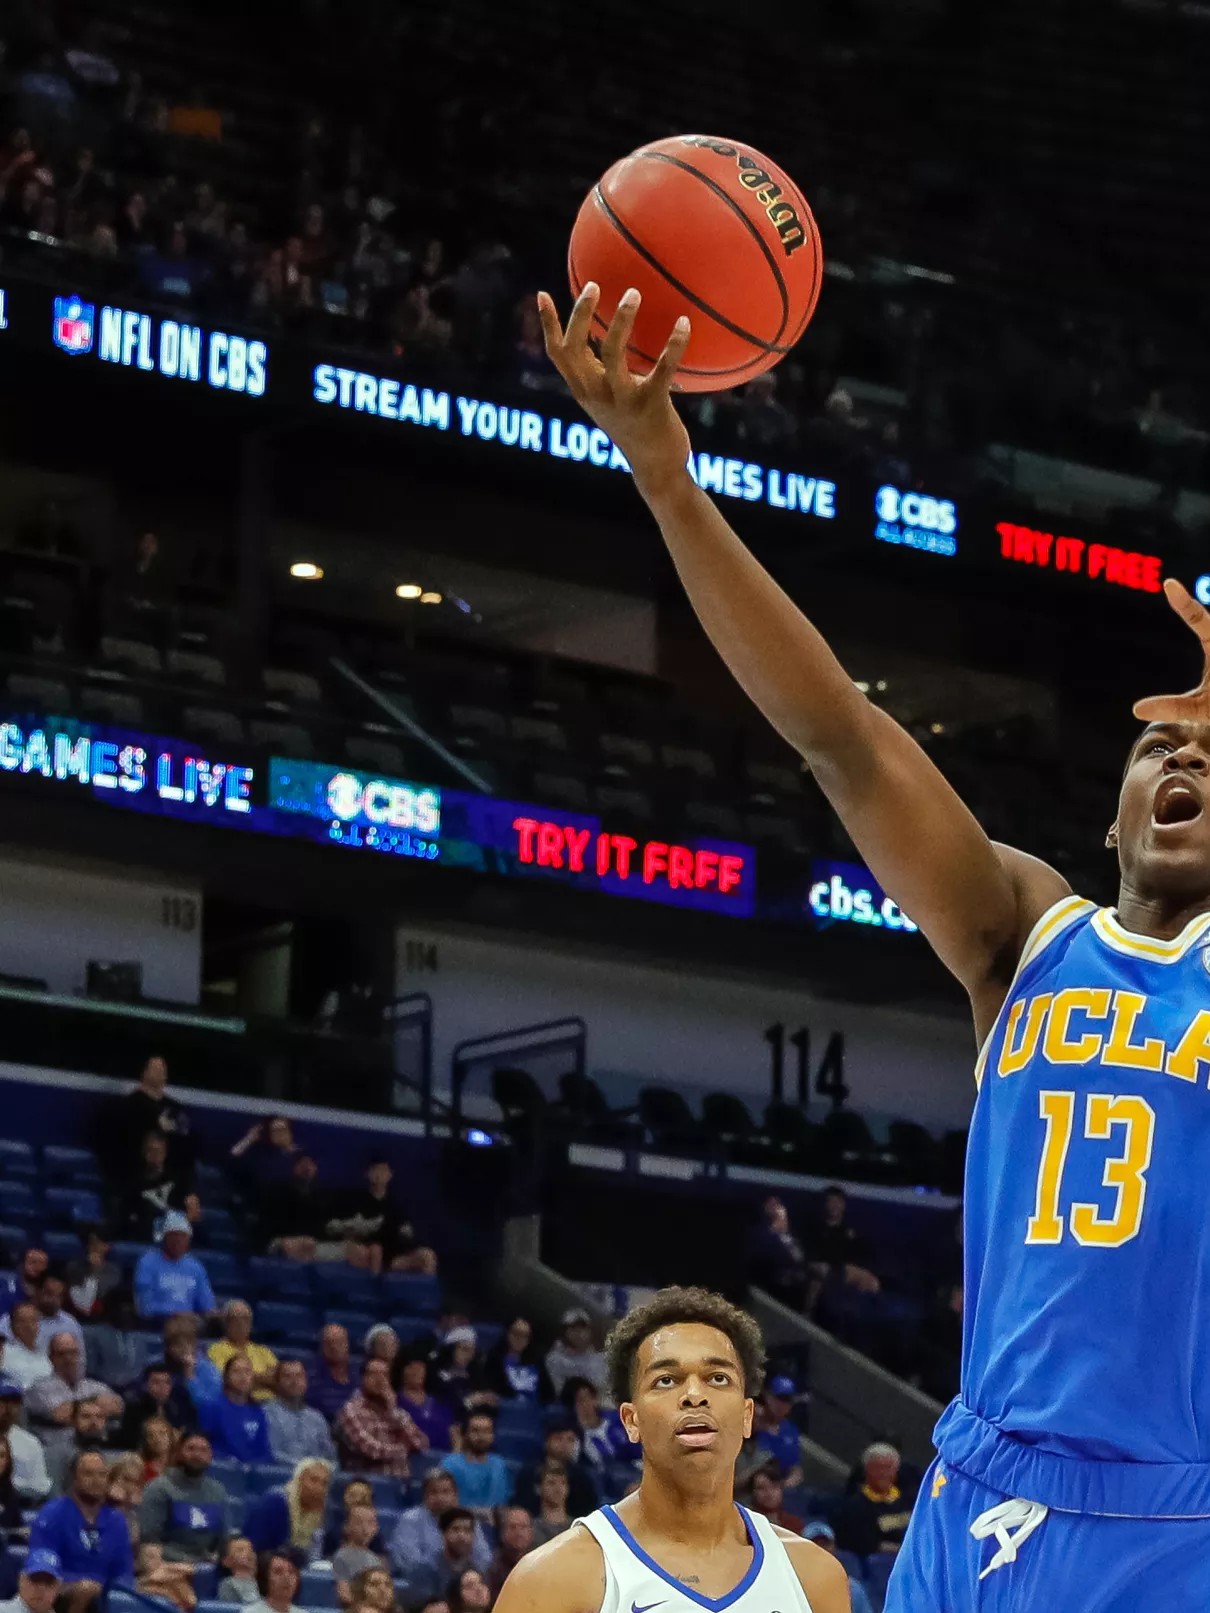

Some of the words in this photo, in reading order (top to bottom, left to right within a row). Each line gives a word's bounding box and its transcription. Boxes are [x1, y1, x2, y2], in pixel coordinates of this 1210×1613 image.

[101, 306, 154, 371] NFL
[159, 320, 201, 382] ON
[209, 331, 268, 397] CBS
[313, 364, 450, 432] STREAM
[456, 397, 544, 453] YOUR
[550, 418, 632, 473] LOCA
[686, 450, 763, 504] MES
[767, 469, 837, 520] LIVE
[901, 492, 958, 537] CBS
[995, 521, 1055, 568] TRY
[1055, 536, 1084, 573] IT
[1086, 543, 1164, 594] FREE
[0, 722, 147, 794] GAMES
[157, 752, 255, 814] LIVE
[361, 779, 441, 834] CBS
[512, 816, 591, 873] TRY
[596, 832, 637, 881] IT
[809, 874, 918, 933] cbs.c
[765, 1022, 850, 1108] 114
[1025, 1090, 1155, 1247] 13
